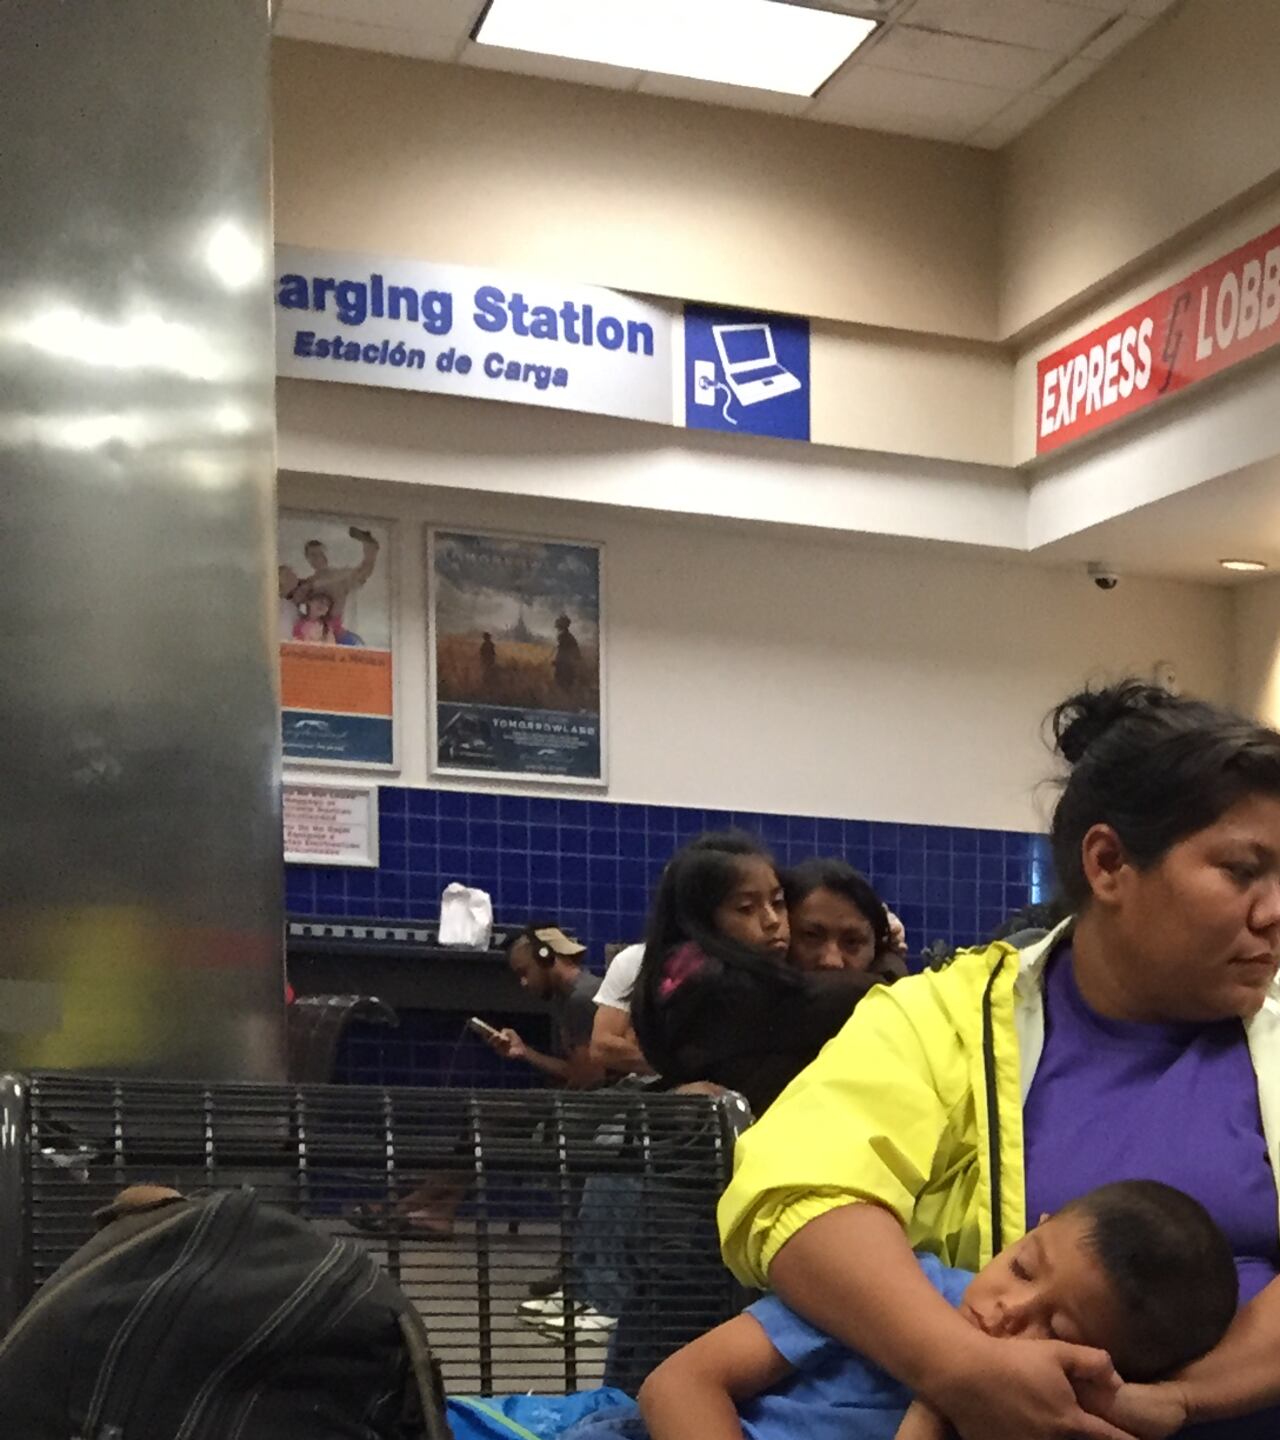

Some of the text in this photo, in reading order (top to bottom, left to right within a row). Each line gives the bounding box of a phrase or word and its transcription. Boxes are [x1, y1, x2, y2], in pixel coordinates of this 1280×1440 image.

[474, 285, 654, 356] Station
[293, 331, 569, 389] Estación de Carga
[1041, 317, 1153, 437] EXPRESS
